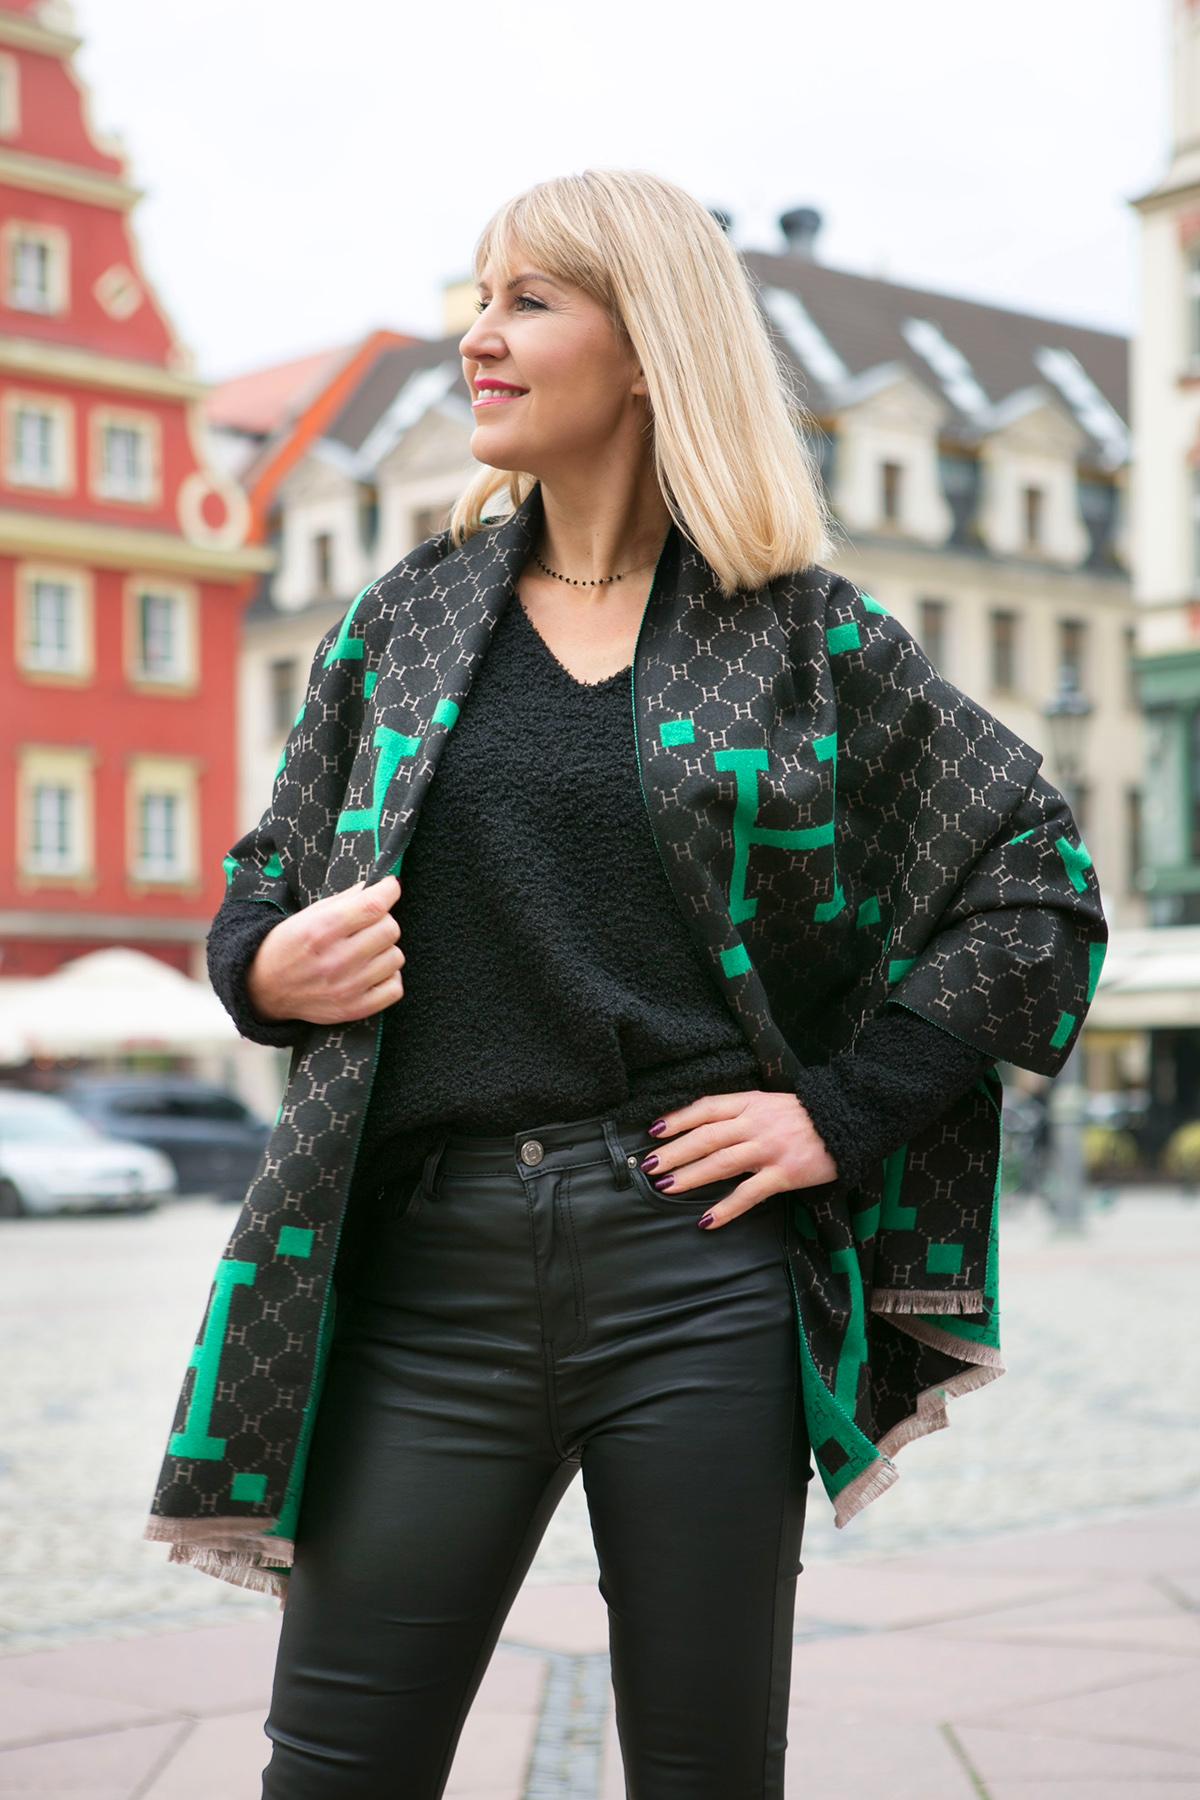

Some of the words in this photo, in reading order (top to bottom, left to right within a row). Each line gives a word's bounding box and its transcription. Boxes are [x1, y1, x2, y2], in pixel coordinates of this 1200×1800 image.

[484, 530, 502, 549] H
[453, 552, 474, 566] H
[492, 548, 510, 562] H
[400, 564, 420, 580] H
[462, 571, 482, 585] H
[430, 585, 450, 601] H
[471, 588, 488, 603] H
[687, 594, 705, 609] H
[380, 603, 399, 621] H
[442, 609, 460, 626] H
[479, 609, 499, 631] H
[836, 605, 856, 623] H
[408, 622, 430, 642] H
[718, 617, 736, 632] H
[451, 628, 467, 646] H
[750, 631, 770, 648] H
[866, 627, 886, 643] H
[696, 640, 713, 655] H
[899, 640, 917, 660] H
[367, 650, 384, 670] H
[422, 652, 441, 669] H
[456, 648, 476, 669] H
[726, 658, 744, 675] H
[810, 650, 830, 673] H
[847, 652, 868, 672] H
[387, 661, 408, 681] H
[671, 664, 689, 680] H
[433, 672, 447, 692] H
[758, 677, 774, 694] H
[880, 672, 898, 692] H
[308, 684, 321, 703] H
[400, 692, 420, 711] H
[647, 692, 664, 711] H
[701, 686, 720, 703] H
[808, 690, 829, 712] H
[907, 685, 926, 704] H
[322, 703, 339, 722] H
[374, 707, 388, 725] H
[734, 701, 753, 720] H
[856, 706, 874, 725] H
[939, 708, 956, 727] H
[415, 719, 430, 736] H
[887, 720, 905, 742] H
[982, 720, 995, 738] H
[291, 735, 300, 757] H
[302, 732, 313, 753] H
[359, 735, 370, 754] H
[709, 730, 728, 748] H
[920, 735, 931, 757] H
[781, 754, 803, 773] H
[1005, 747, 1026, 761] H
[322, 755, 338, 774] H
[396, 765, 413, 783] H
[684, 758, 704, 776] H
[864, 757, 885, 777] H
[941, 760, 960, 779] H
[989, 765, 1008, 782] H
[276, 770, 289, 791] H
[817, 770, 831, 792] H
[901, 770, 917, 788] H
[301, 783, 314, 806] H
[349, 786, 364, 806] H
[660, 787, 679, 808] H
[719, 781, 734, 800] H
[770, 780, 788, 799] H
[846, 789, 864, 808] H
[920, 789, 931, 808] H
[970, 787, 986, 807] H
[1029, 788, 1047, 808] H
[380, 809, 401, 830] H
[694, 808, 711, 828] H
[798, 803, 811, 822] H
[881, 802, 899, 821] H
[942, 813, 960, 832] H
[304, 835, 316, 856] H
[340, 838, 356, 857] H
[720, 829, 734, 849] H
[864, 835, 881, 857] H
[1032, 838, 1055, 858] H
[251, 847, 269, 869] H
[279, 846, 294, 869] H
[674, 842, 693, 860] H
[917, 841, 931, 861] H
[790, 856, 808, 872] H
[894, 853, 905, 873] H
[756, 873, 774, 890] H
[942, 866, 959, 885] H
[990, 864, 1013, 885] H
[1029, 875, 1050, 893] H
[254, 880, 276, 895] H
[813, 877, 830, 896] H
[876, 885, 891, 905] H
[690, 894, 711, 914] H
[913, 895, 930, 915] H
[1064, 889, 1081, 905] H
[751, 920, 767, 937] H
[892, 926, 903, 947] H
[1001, 927, 1022, 949] H
[1075, 926, 1088, 944] H
[962, 936, 986, 956] H
[1037, 942, 1055, 958] H
[929, 951, 950, 970] H
[1010, 957, 1033, 980] H
[972, 972, 995, 996] H
[1048, 974, 1061, 992] H
[934, 988, 958, 1011] H
[1074, 984, 1086, 1002] H
[1018, 995, 1039, 1015] H
[982, 1013, 1004, 1034] H
[325, 1032, 344, 1048] H
[1021, 1031, 1041, 1049] H
[297, 1054, 312, 1072] H
[341, 1059, 363, 1080] H
[767, 1057, 783, 1077] H
[308, 1081, 328, 1101] H
[280, 1104, 298, 1124] H
[973, 1098, 990, 1119] H
[329, 1111, 349, 1133] H
[941, 1125, 960, 1144] H
[294, 1133, 315, 1156] H
[264, 1158, 282, 1178] H
[908, 1152, 927, 1171] H
[968, 1153, 987, 1173] H
[318, 1168, 337, 1188] H
[934, 1180, 955, 1200] H
[283, 1190, 304, 1211] H
[249, 1211, 269, 1232] H
[813, 1202, 833, 1223] H
[960, 1209, 979, 1229] H
[892, 1264, 911, 1285] H
[296, 1277, 315, 1298] H
[261, 1301, 282, 1322] H
[226, 1324, 247, 1345] H
[284, 1333, 305, 1352] H
[251, 1356, 271, 1378] H
[217, 1381, 237, 1402] H
[275, 1388, 295, 1408] H
[241, 1414, 260, 1433] H
[264, 1441, 284, 1460] H
[173, 1463, 194, 1484] H
[200, 1493, 218, 1512] H
